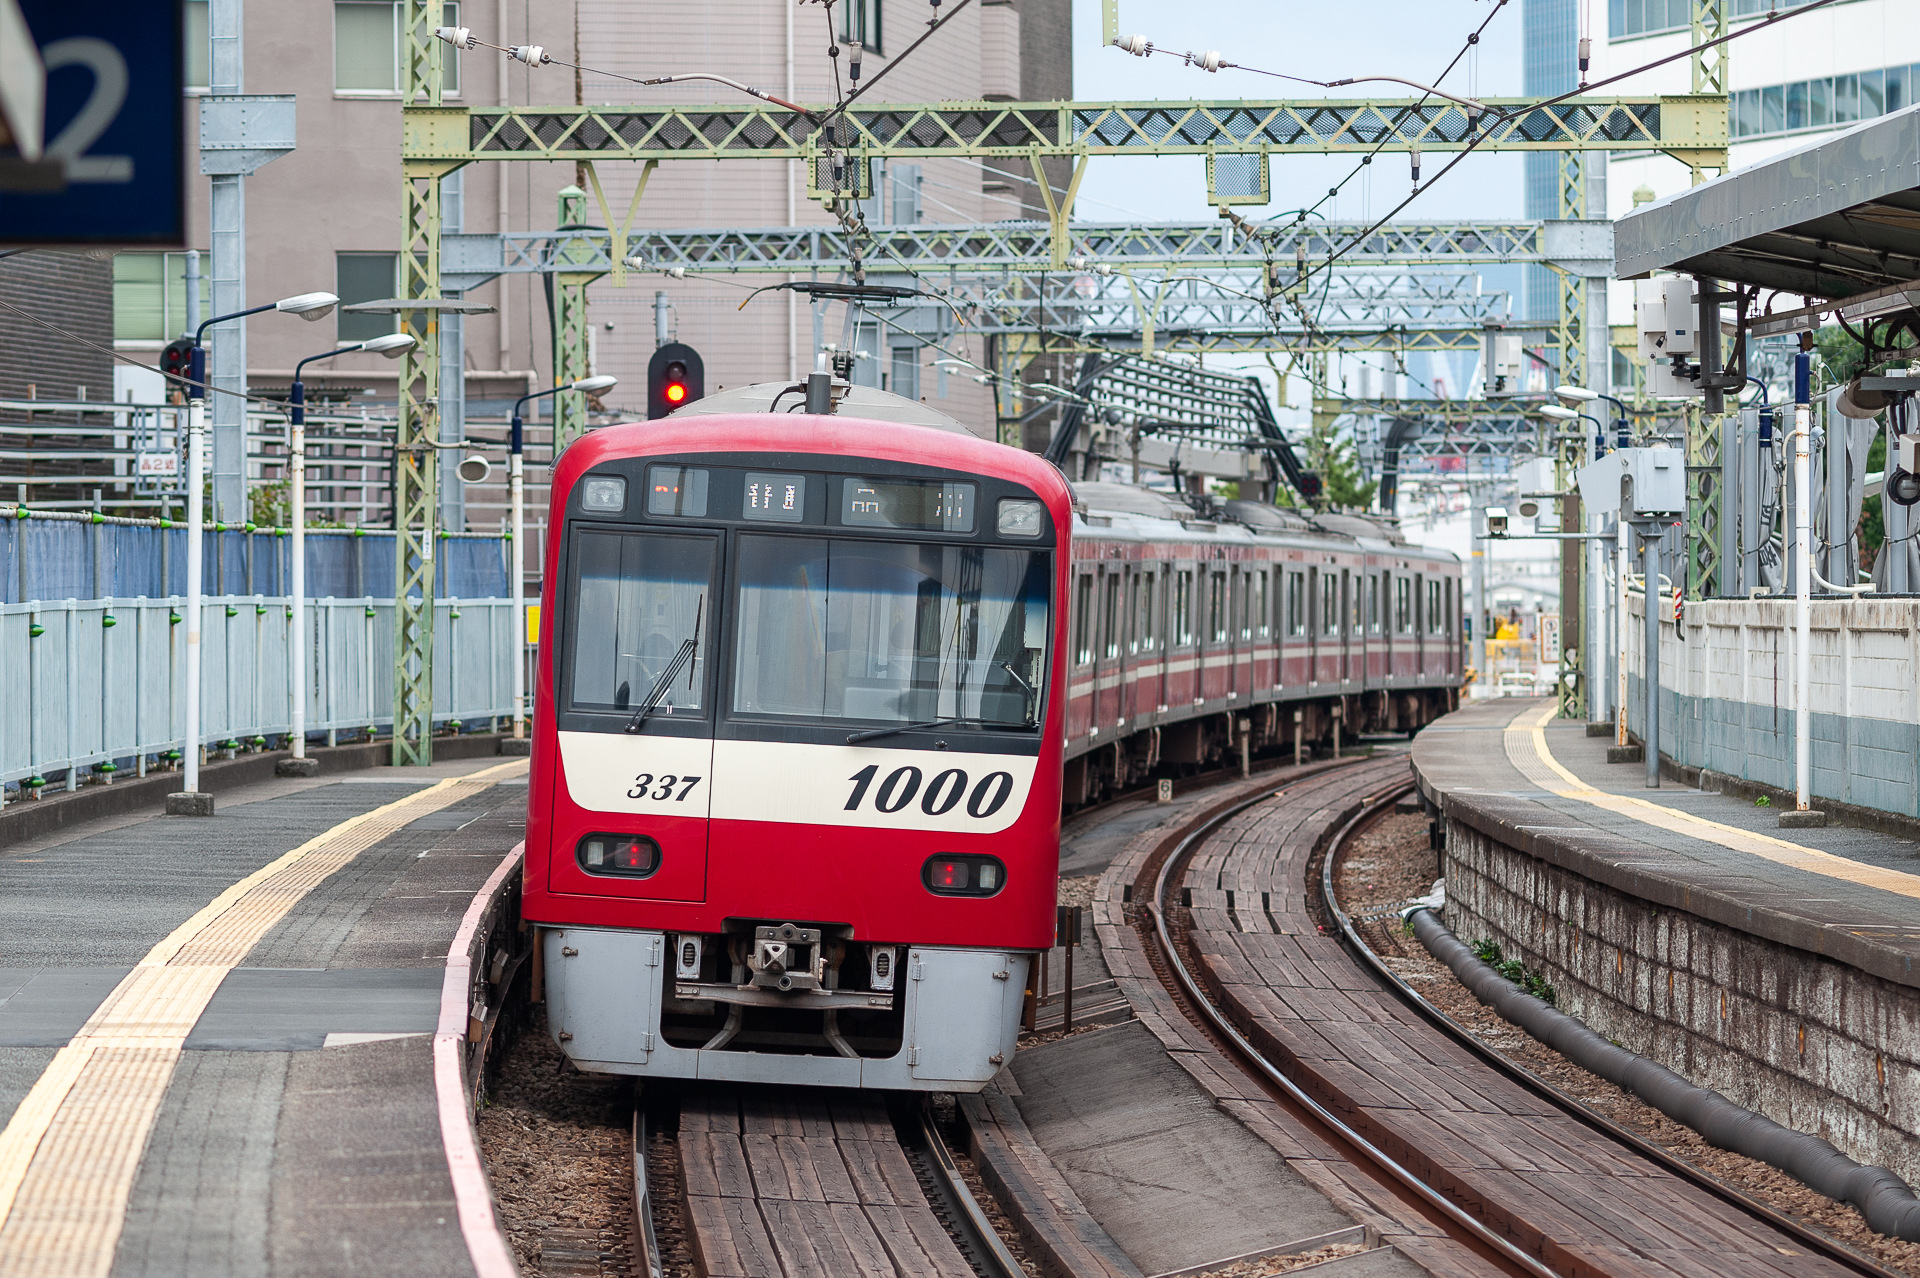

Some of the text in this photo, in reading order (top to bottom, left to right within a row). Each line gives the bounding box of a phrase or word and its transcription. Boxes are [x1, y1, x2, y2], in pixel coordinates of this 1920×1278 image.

[42, 36, 135, 184] 2
[626, 773, 702, 802] 337
[843, 764, 1014, 819] 1000
